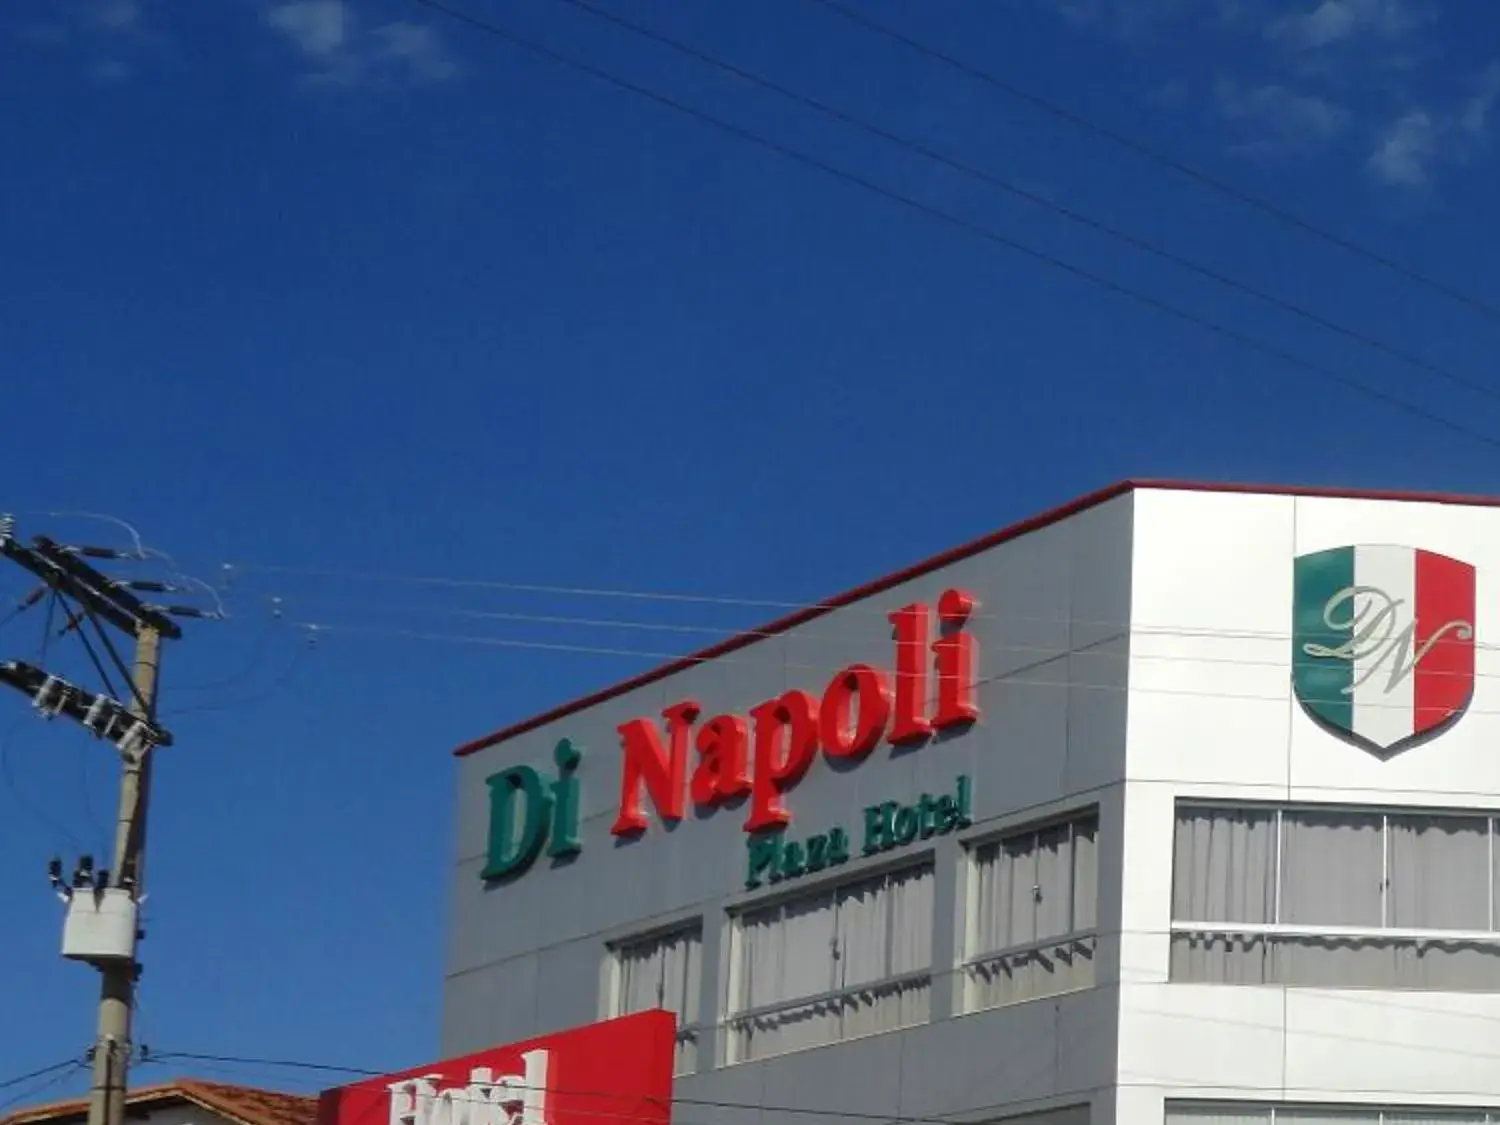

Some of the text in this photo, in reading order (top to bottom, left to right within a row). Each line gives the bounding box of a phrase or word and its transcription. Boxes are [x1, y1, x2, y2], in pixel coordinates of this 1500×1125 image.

[481, 588, 982, 880] Di Napoli
[744, 774, 972, 890] Plaza Hotel
